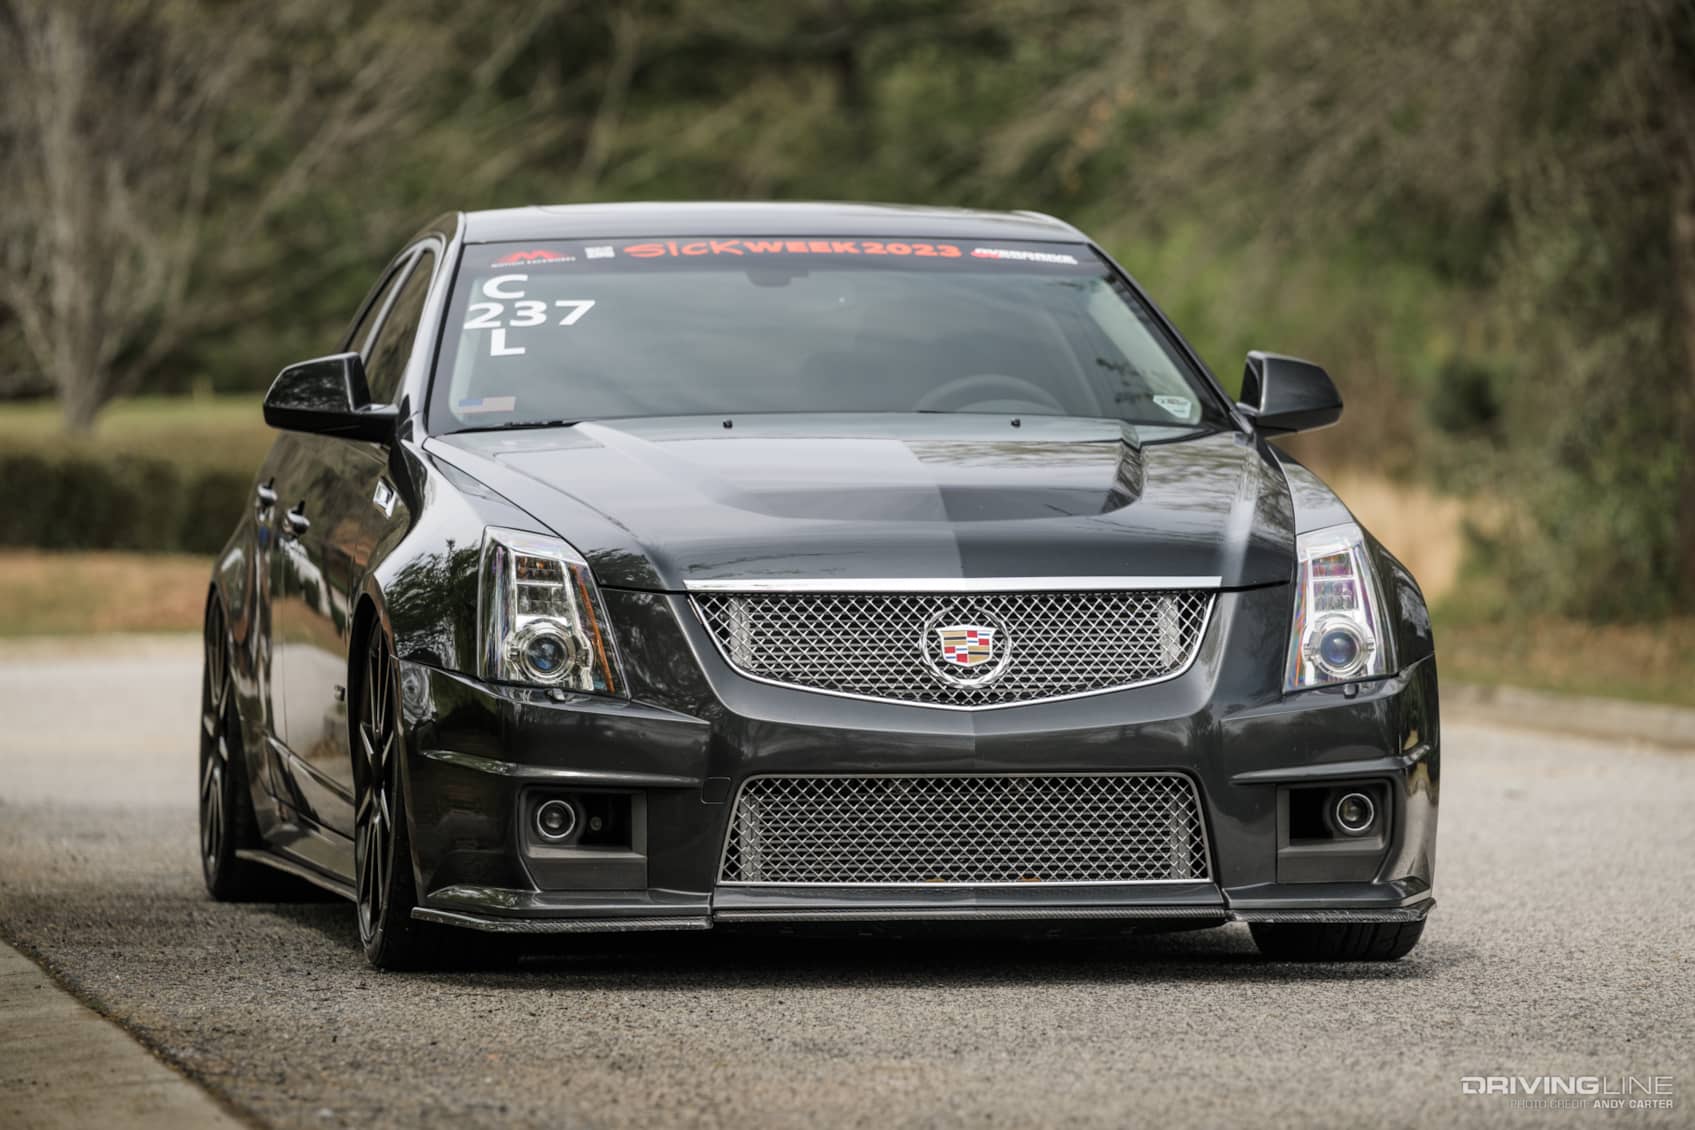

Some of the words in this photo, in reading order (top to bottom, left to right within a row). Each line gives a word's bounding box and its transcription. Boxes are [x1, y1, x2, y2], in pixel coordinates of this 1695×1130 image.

[482, 274, 528, 299] C
[463, 300, 596, 329] 237
[490, 328, 525, 356] L
